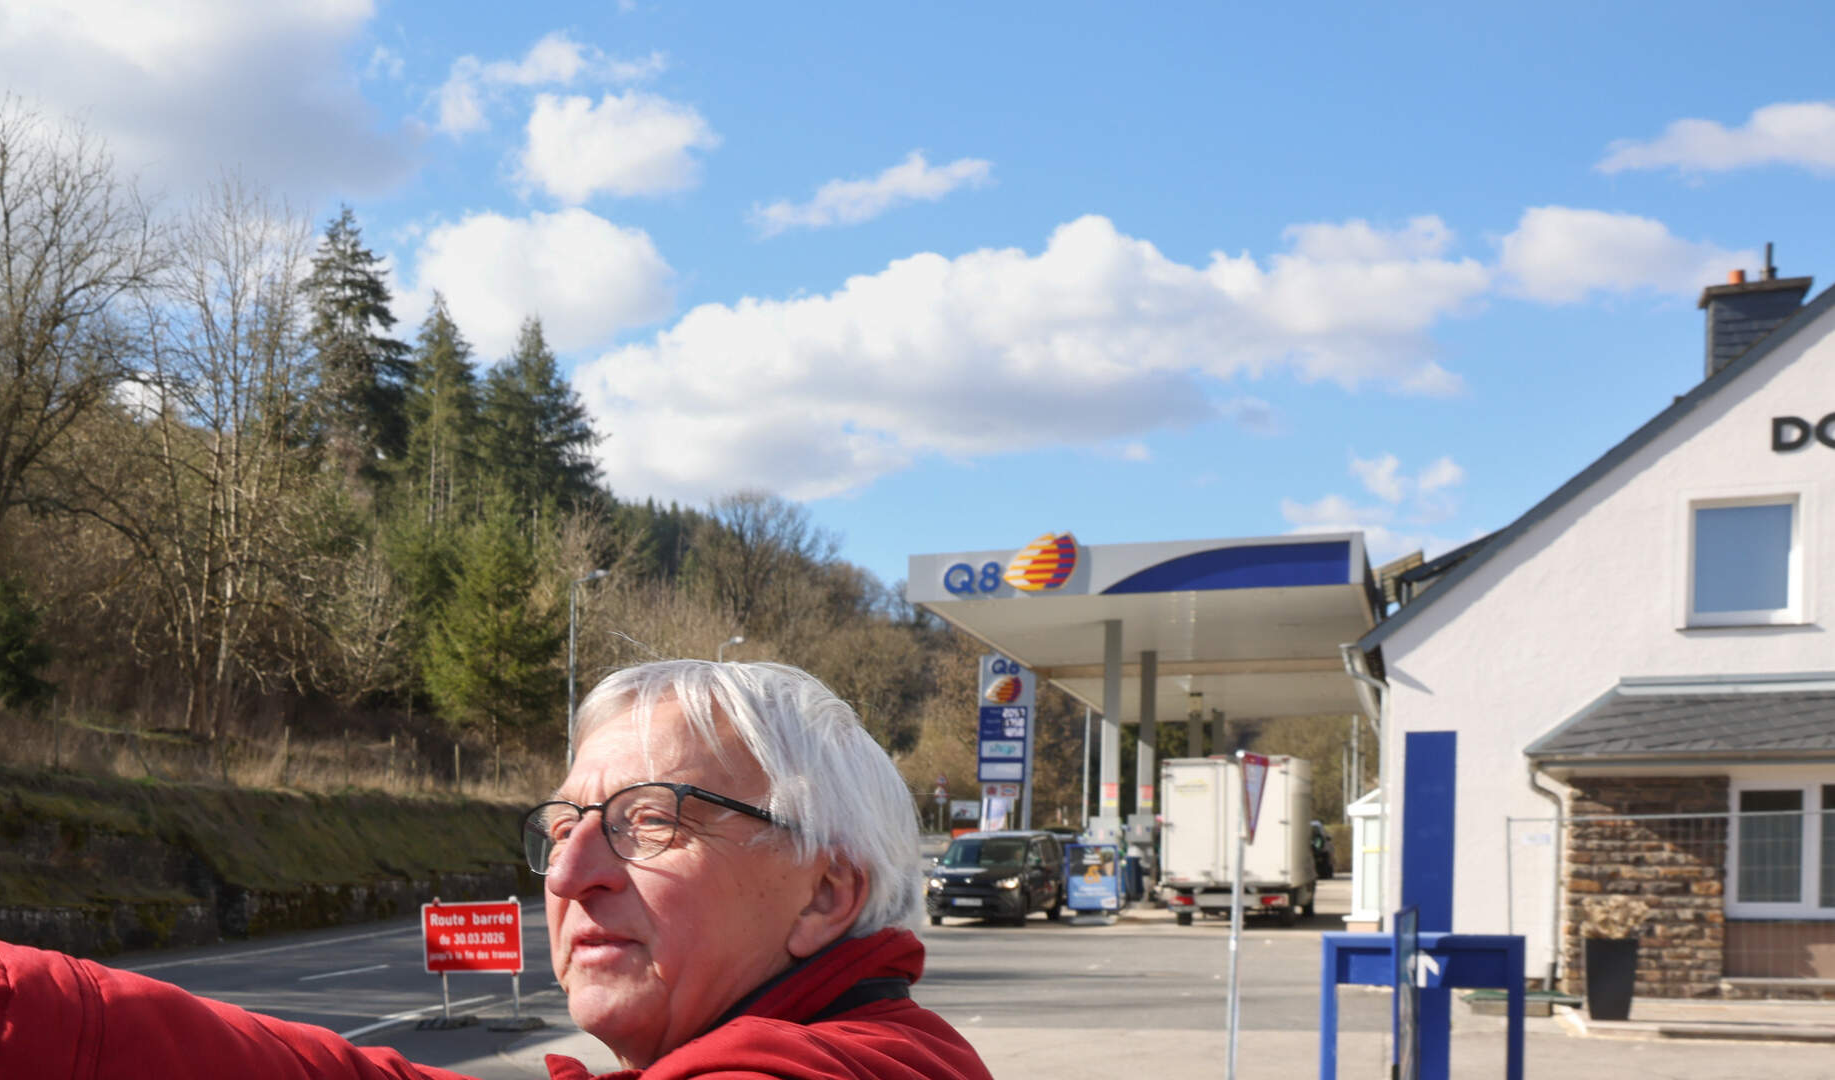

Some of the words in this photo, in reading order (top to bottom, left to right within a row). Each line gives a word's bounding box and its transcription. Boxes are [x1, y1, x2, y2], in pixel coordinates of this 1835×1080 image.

[944, 561, 1001, 594] Q8
[430, 913, 465, 926] Route
[472, 912, 513, 925] barrée
[453, 932, 505, 944] 30.03.2026
